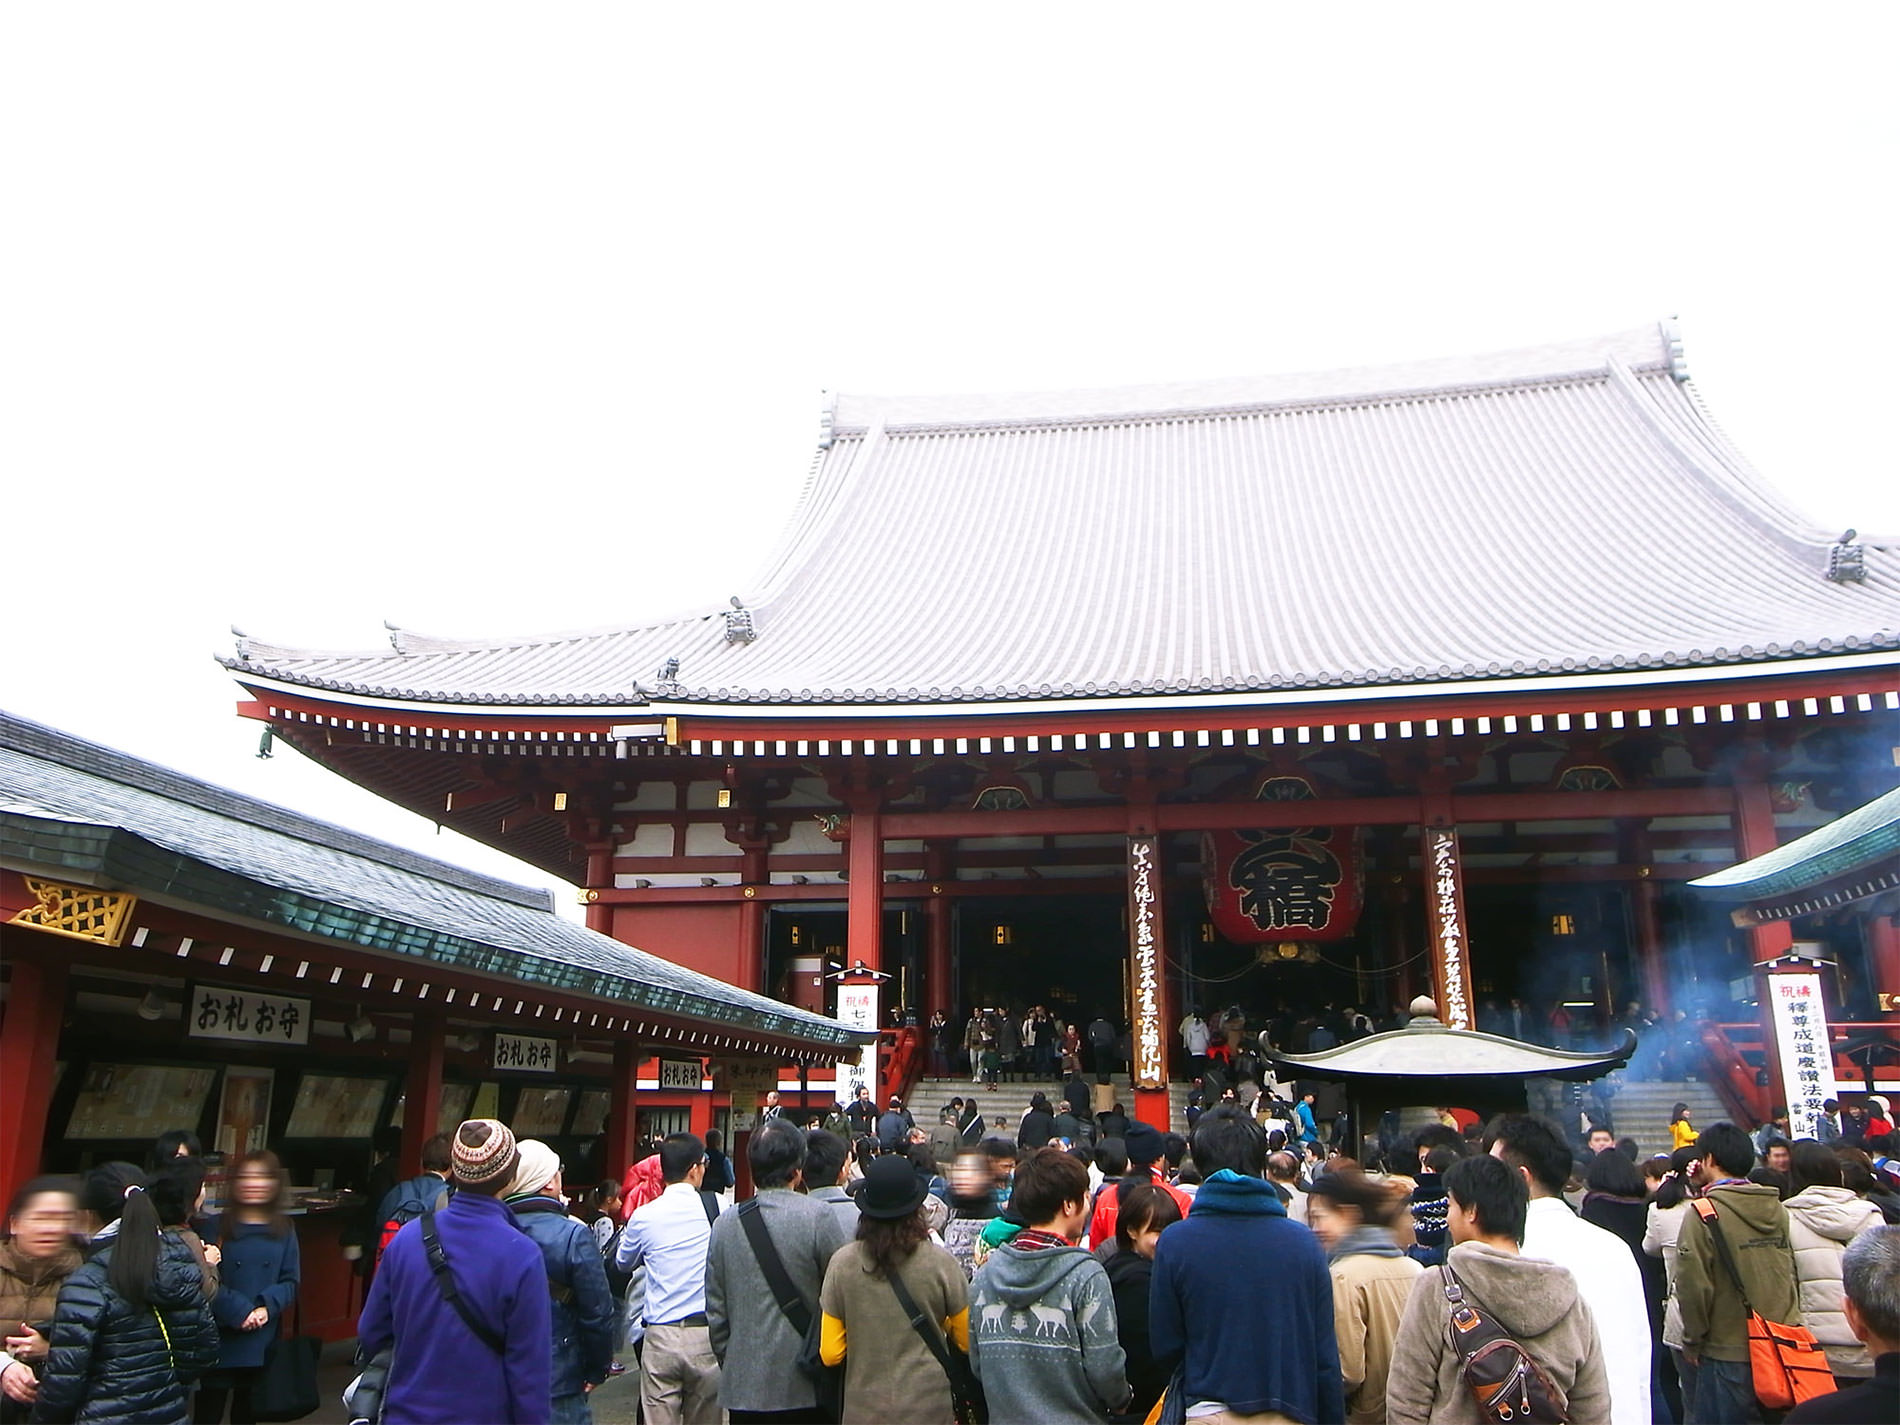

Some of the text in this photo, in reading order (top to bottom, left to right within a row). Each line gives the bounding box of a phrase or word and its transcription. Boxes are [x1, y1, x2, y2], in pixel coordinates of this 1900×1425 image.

[198, 991, 300, 1040] お札お守
[496, 1040, 552, 1069] お札お守
[663, 1062, 698, 1088] お札お守
